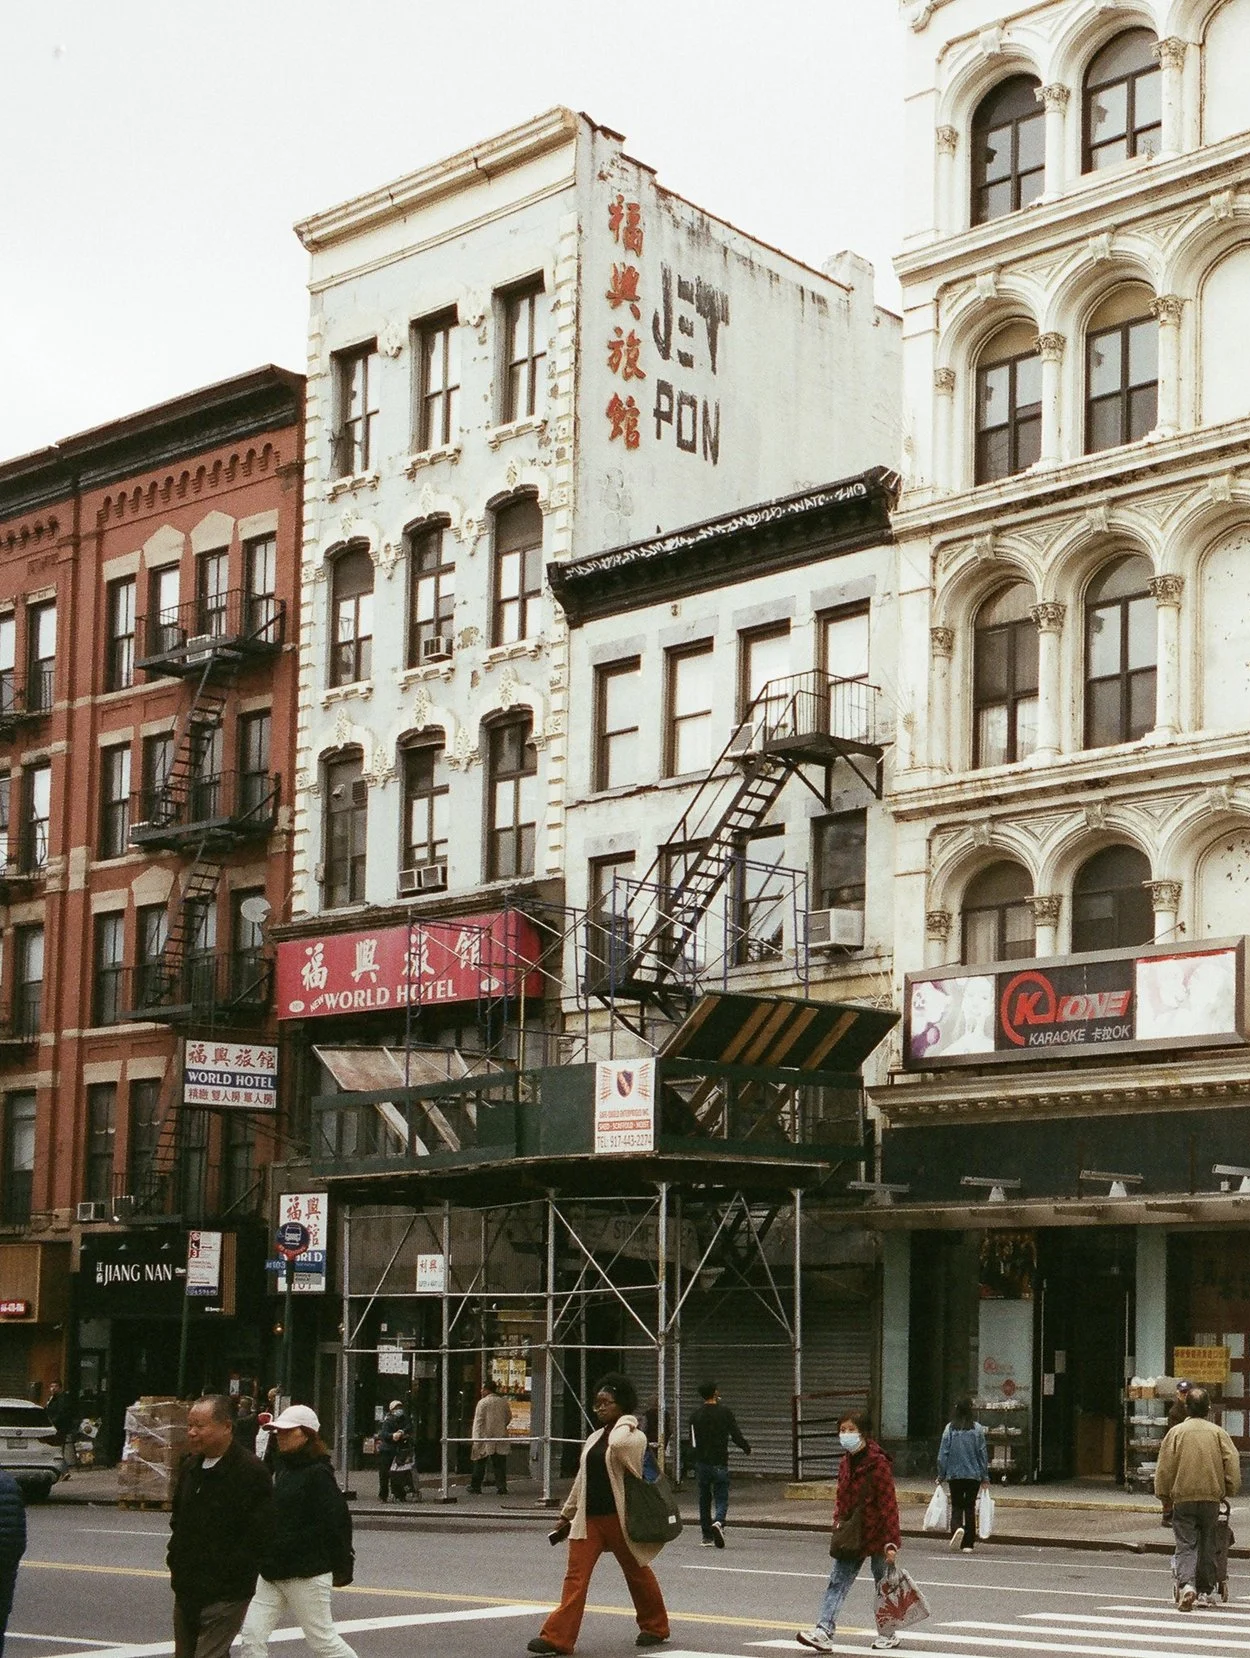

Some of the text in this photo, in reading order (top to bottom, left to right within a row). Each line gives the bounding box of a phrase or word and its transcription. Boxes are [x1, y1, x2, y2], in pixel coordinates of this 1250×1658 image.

[324, 986, 390, 1010] WORLD
[396, 979, 458, 1002] HOTEL
[1029, 1028, 1086, 1046] KARAOKE
[188, 1043, 275, 1069] 福興旅館
[187, 1071, 274, 1088] WORLD HOTEL
[104, 1263, 173, 1286] JIANG NAN
